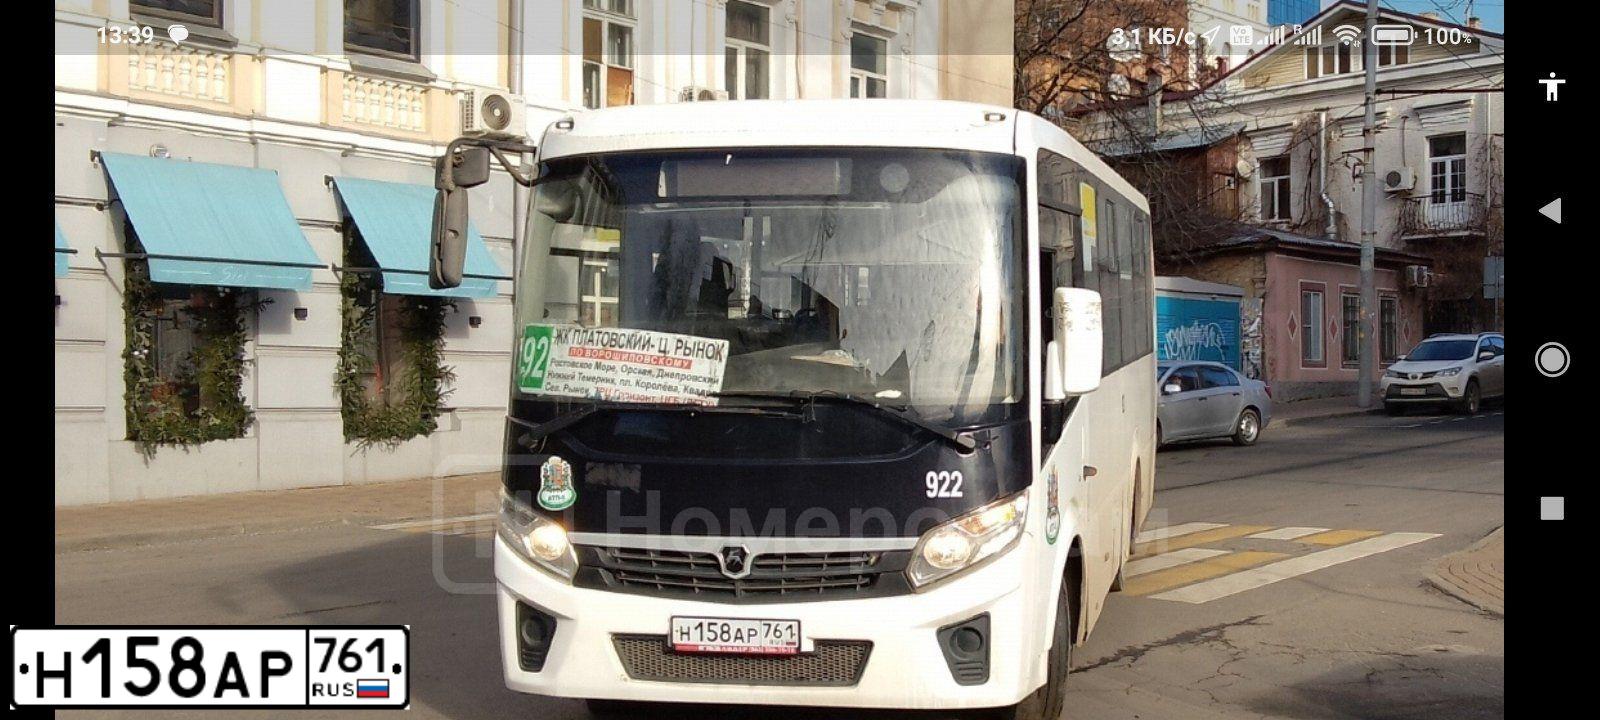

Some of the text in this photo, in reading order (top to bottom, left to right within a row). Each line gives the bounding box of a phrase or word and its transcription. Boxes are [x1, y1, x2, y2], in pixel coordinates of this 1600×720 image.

[522, 336, 549, 378] 92
[570, 347, 689, 368] ПО ВОРОШИЛОВСКОМУ
[674, 339, 725, 363] РЫНОК
[925, 471, 963, 498] 922
[680, 622, 795, 644] Н158АР 761
